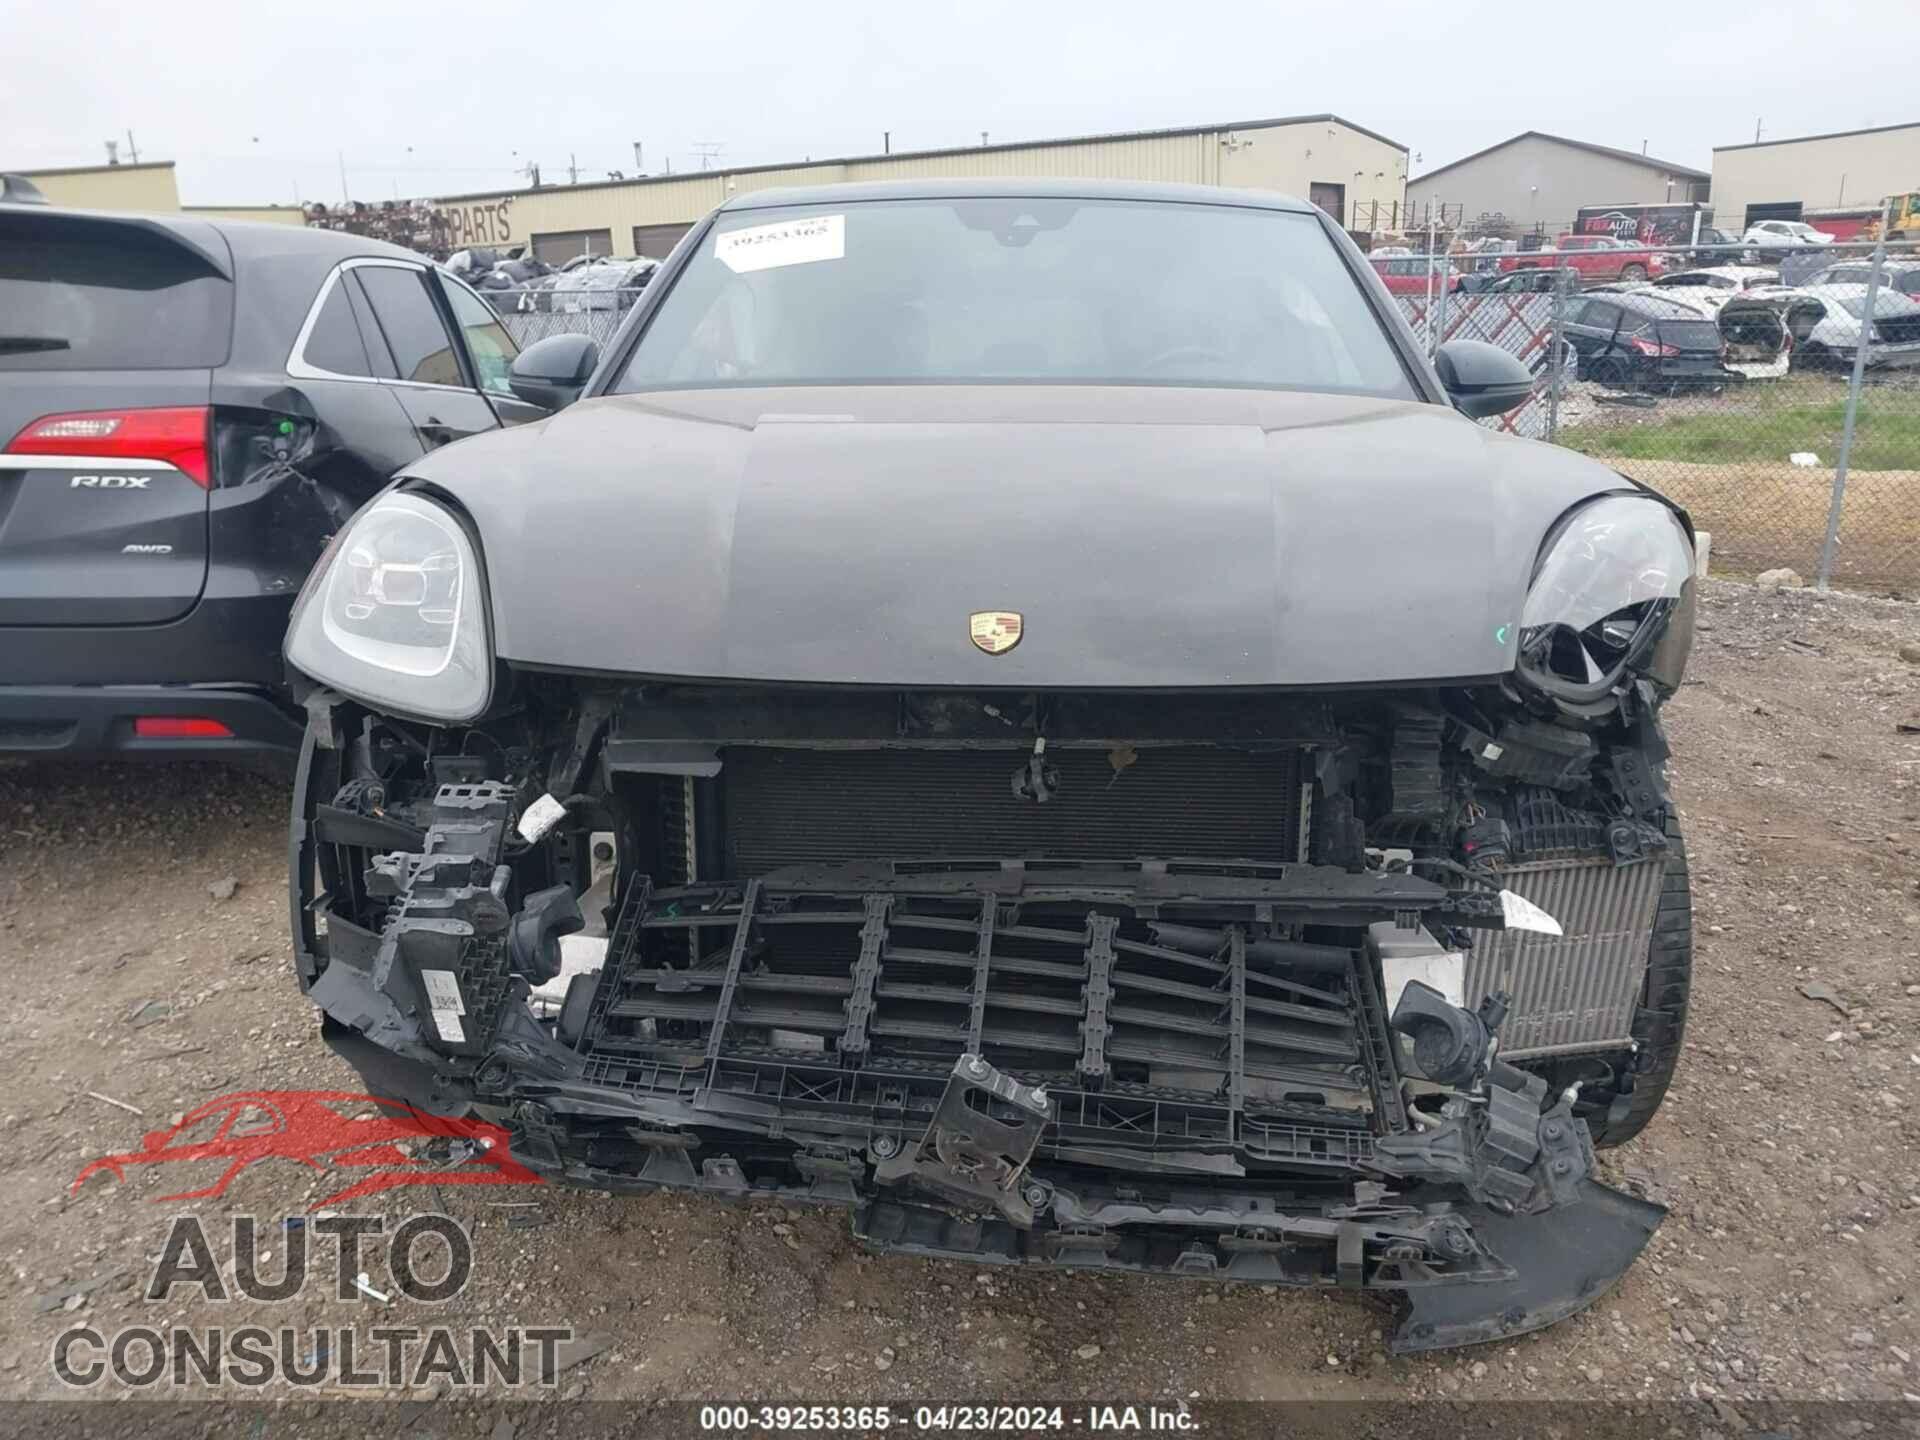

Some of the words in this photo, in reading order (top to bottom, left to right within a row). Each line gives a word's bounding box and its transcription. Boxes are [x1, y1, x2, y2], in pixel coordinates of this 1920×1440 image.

[449, 202, 511, 246] PARTS
[1608, 218, 1638, 231] AUTO
[70, 475, 152, 489] RDX
[120, 543, 173, 555] AWD
